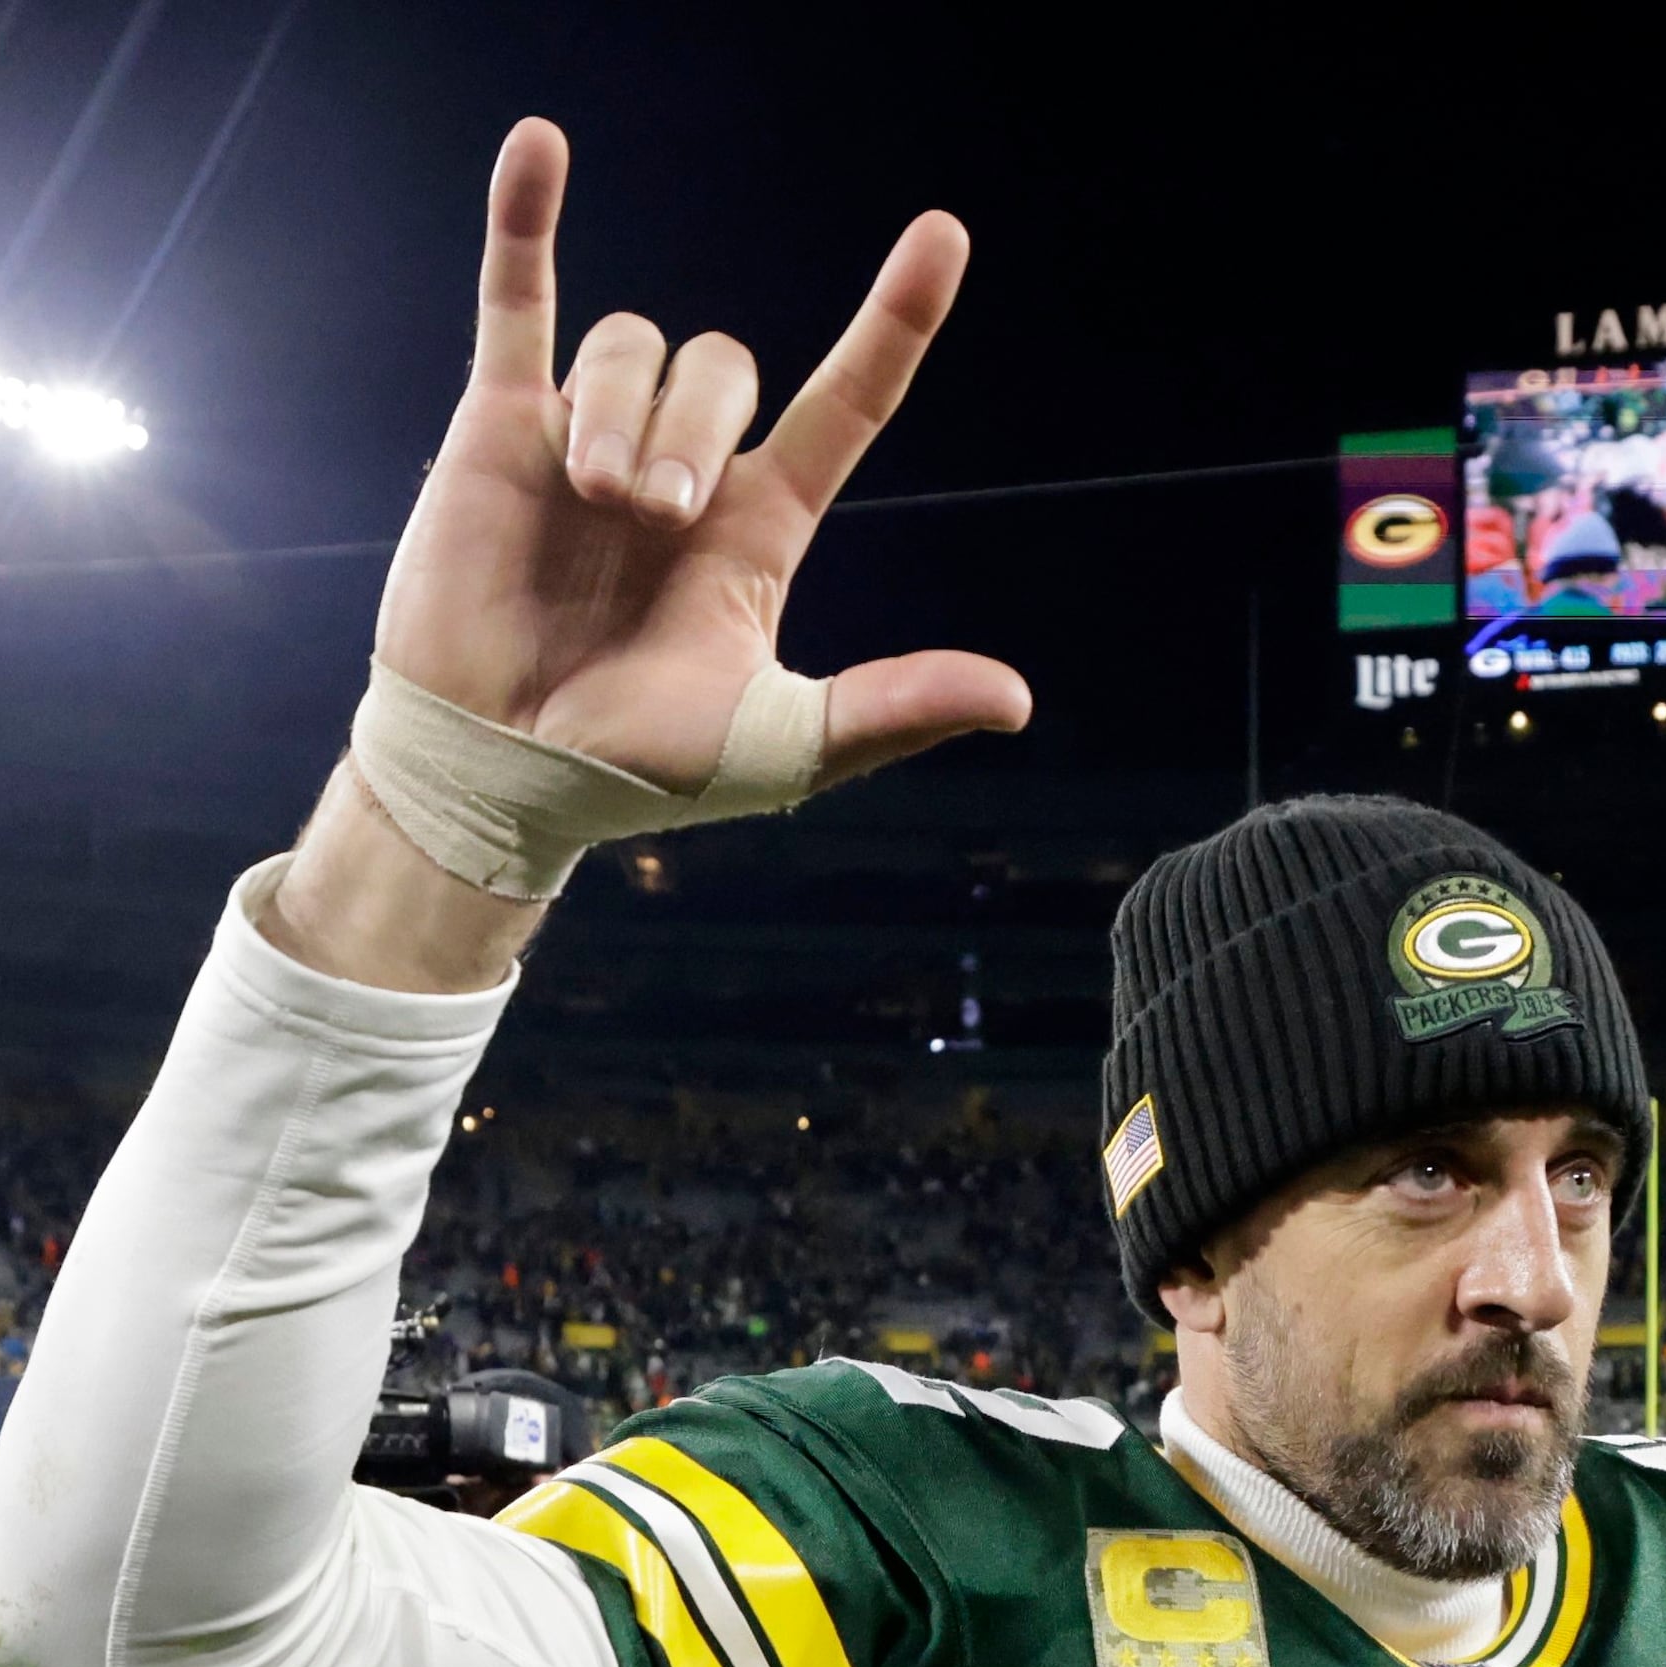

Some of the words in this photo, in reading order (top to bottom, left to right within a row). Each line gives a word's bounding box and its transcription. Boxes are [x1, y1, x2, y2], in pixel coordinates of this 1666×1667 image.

[1356, 654, 1440, 710] Lite
[1399, 985, 1509, 1032] PACKERS
[1100, 1538, 1252, 1642] C
